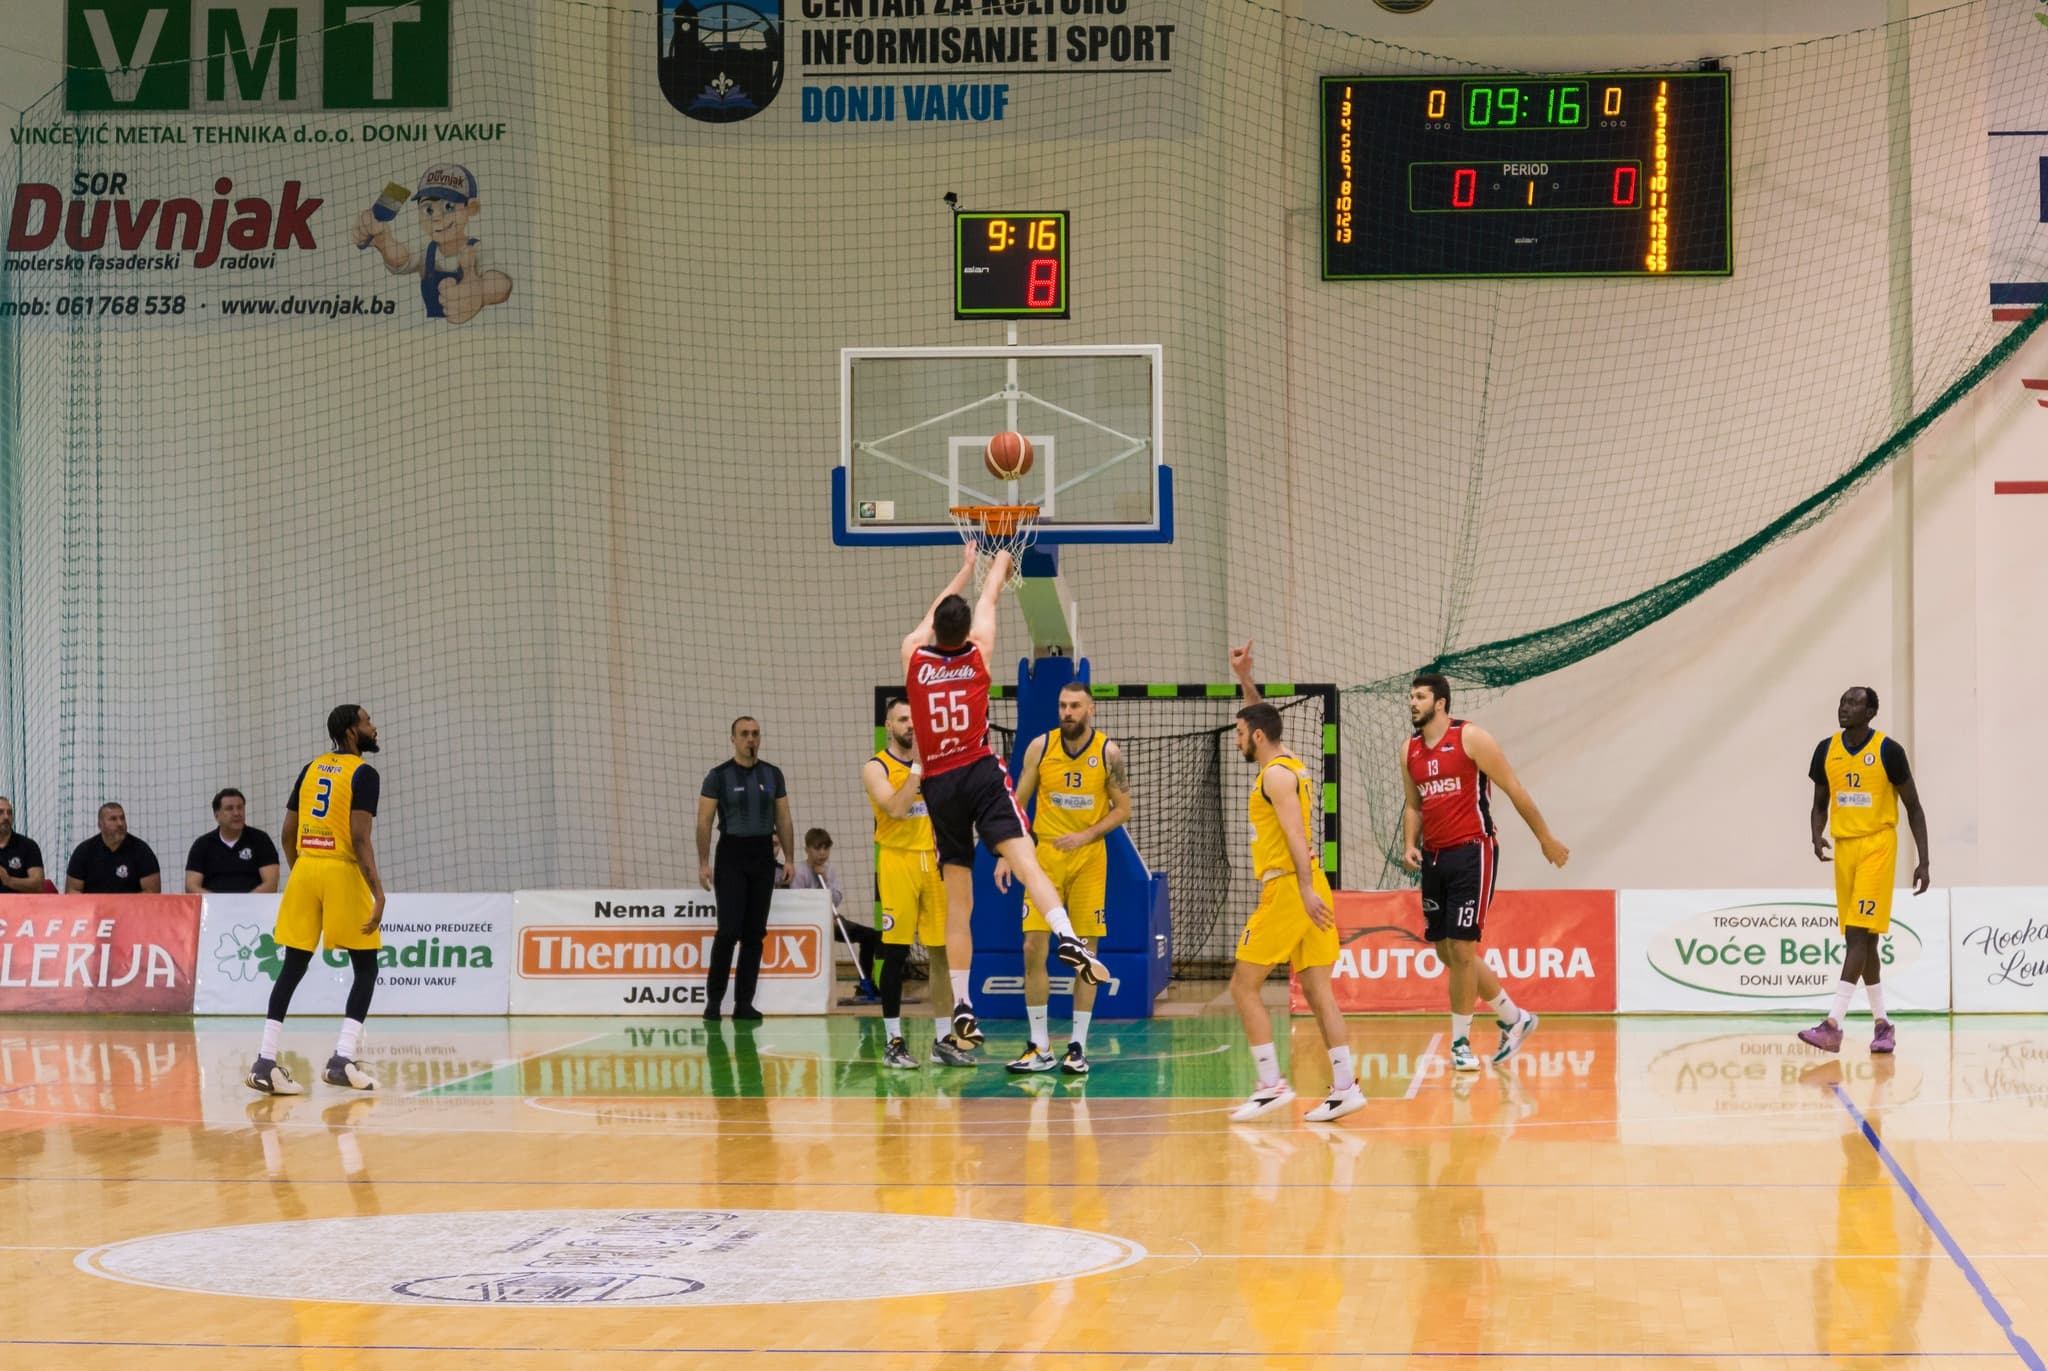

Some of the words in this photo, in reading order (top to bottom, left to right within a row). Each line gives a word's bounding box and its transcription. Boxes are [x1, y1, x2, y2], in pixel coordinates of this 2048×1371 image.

[83, 6, 421, 102] VMT
[802, 26, 1038, 65] INFORMISANJE
[1048, 26, 1057, 62] I
[1066, 25, 1175, 62] SPORT
[802, 85, 894, 122] DONJI
[903, 84, 1008, 121] VAKUF
[1342, 101, 1351, 116] 3
[1428, 90, 1446, 119] 0
[1469, 87, 1580, 126] 09:16
[1604, 87, 1622, 116] 0
[10, 122, 109, 145] VINČEVIĆ
[116, 126, 186, 144] METAL
[192, 126, 287, 144] TEHNIKA
[294, 126, 355, 143] d.o.o.
[363, 124, 427, 142] DONJI
[434, 123, 507, 142] VAKUF
[1341, 134, 1351, 148] 5
[1341, 150, 1351, 164] 6
[1503, 164, 1549, 176] PERIOD
[72, 172, 128, 195] SOR
[1341, 180, 1351, 195] 8
[1452, 168, 1477, 208] 0
[1528, 180, 1535, 206] 1
[1612, 167, 1637, 205] 0
[1650, 176, 1667, 192] 10
[1336, 196, 1352, 211] 10
[1650, 192, 1667, 207] 11
[6, 177, 324, 268] Duvnjak
[1336, 212, 1352, 227] 12
[1650, 208, 1667, 223] 12
[988, 220, 1057, 251] 9:16
[1336, 228, 1352, 243] 13
[1651, 224, 1667, 239] 13
[4, 254, 85, 272] molersko
[89, 253, 180, 271] fasaderski
[220, 253, 276, 270] radovi
[1646, 255, 1667, 272] 55
[1026, 259, 1058, 307] 8
[0, 297, 51, 316] mob:
[56, 296, 95, 316] 061
[100, 296, 139, 316] 768
[144, 294, 186, 315] 538
[222, 295, 396, 320] www.duvnjak.ba
[928, 690, 969, 734] 55
[1428, 760, 1439, 777] 13
[1064, 772, 1082, 788] 13
[1846, 773, 1861, 788] 12
[312, 778, 332, 819] 3
[595, 901, 665, 919] Nema
[675, 901, 717, 918] zim
[1456, 907, 1474, 928] 13
[1858, 900, 1876, 916] 12
[380, 923, 432, 933] MUNALNO
[435, 921, 493, 933] PREDUZEĆE
[1713, 914, 1797, 928] TRGOVAČKA
[1802, 916, 1839, 928] RADN
[1962, 918, 2048, 955] Hooka
[322, 937, 494, 968] Gadina
[1675, 936, 1766, 966] Voće
[1780, 936, 1895, 966] Bekš
[0, 944, 176, 988] LERIJA
[1331, 948, 1445, 979] AUTO
[1484, 947, 1596, 979] AURA
[1988, 949, 2048, 987] Lou
[390, 976, 421, 986] DONJI
[424, 976, 457, 986] VAKUF
[1740, 975, 1783, 987] DONJI
[1788, 974, 1829, 986] VAKUF
[624, 986, 705, 1004] JAJCE
